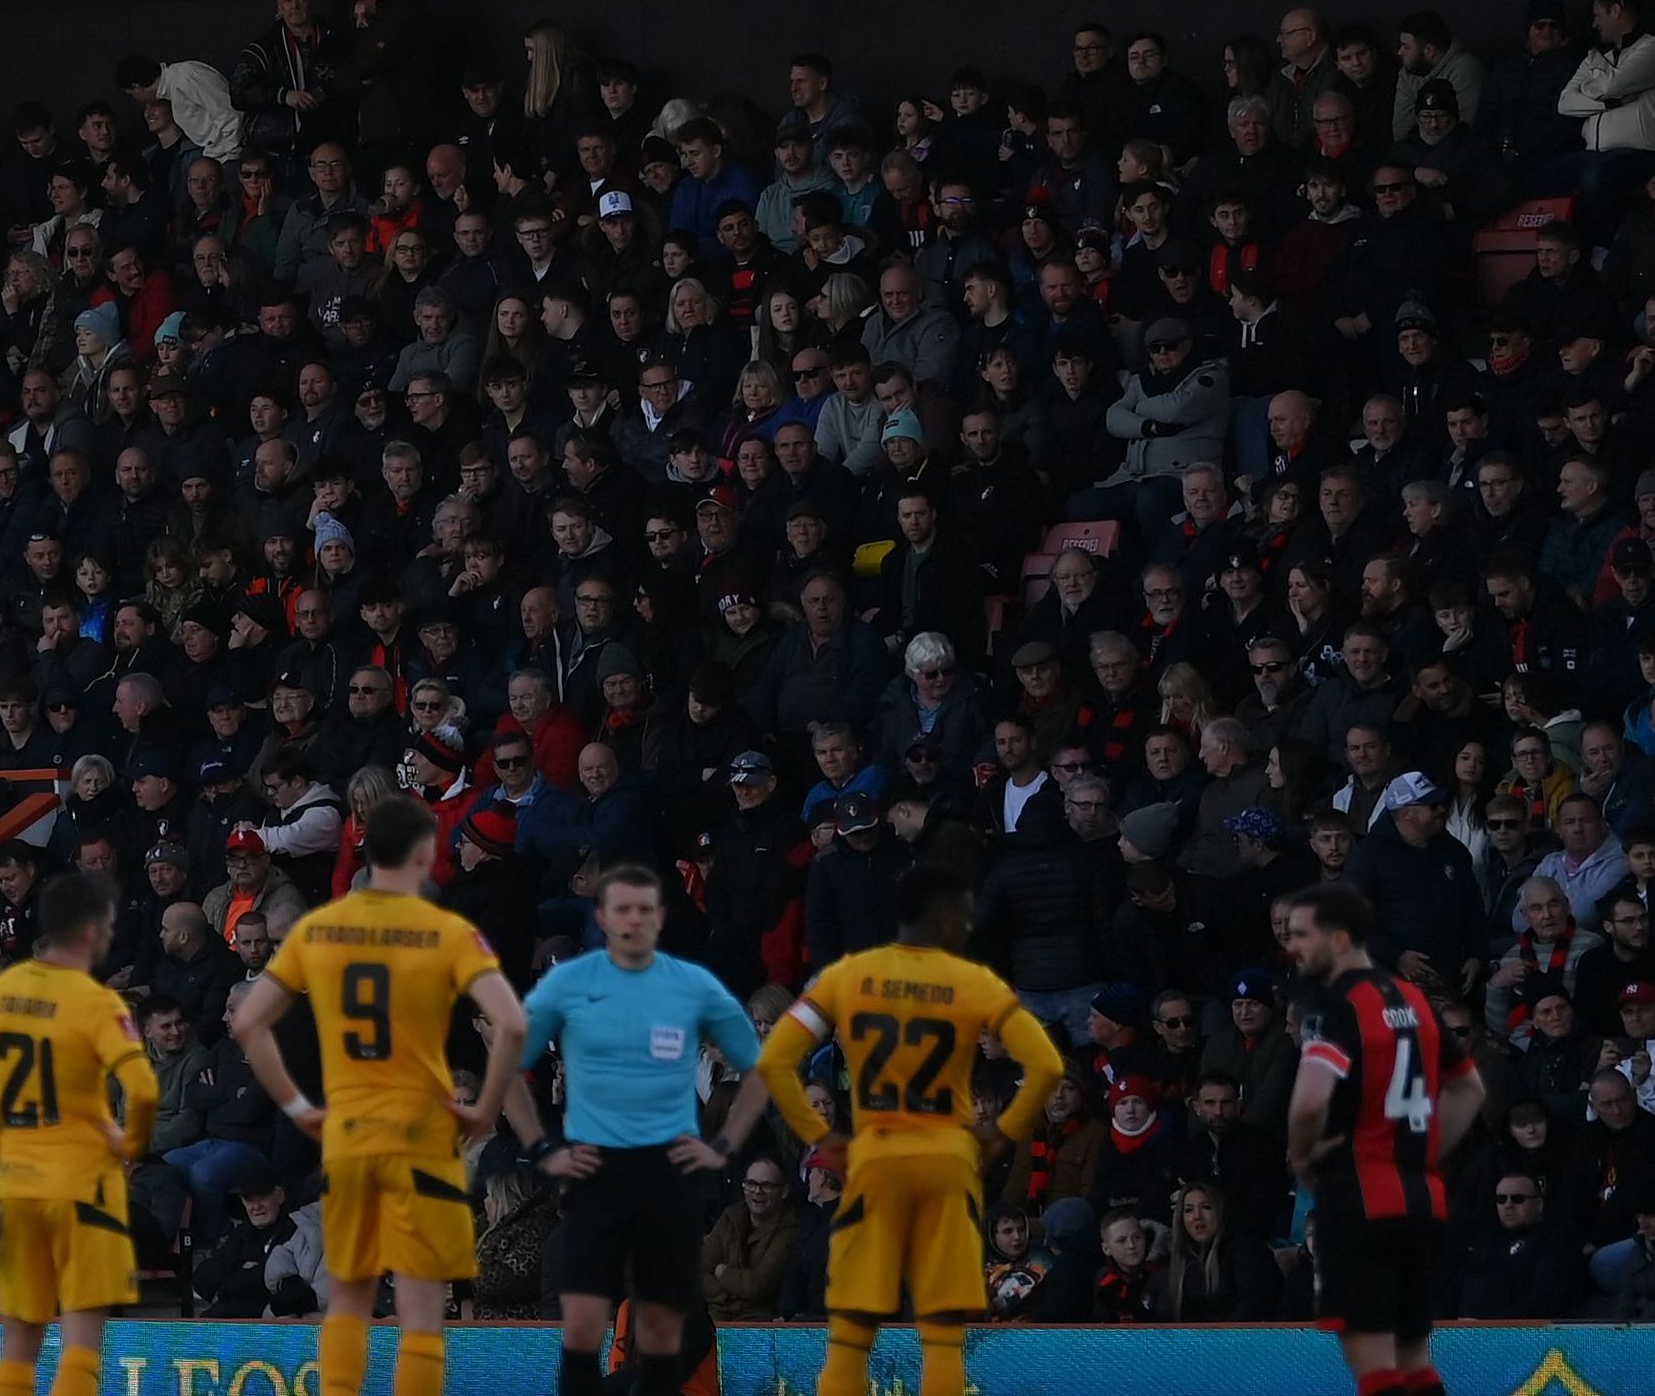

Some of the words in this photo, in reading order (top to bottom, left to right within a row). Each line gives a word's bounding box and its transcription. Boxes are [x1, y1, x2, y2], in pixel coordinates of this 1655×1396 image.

[344, 963, 391, 1060] 9
[1382, 1008, 1419, 1028] COOK
[851, 1012, 955, 1115] 22
[1384, 1038, 1432, 1132] 4
